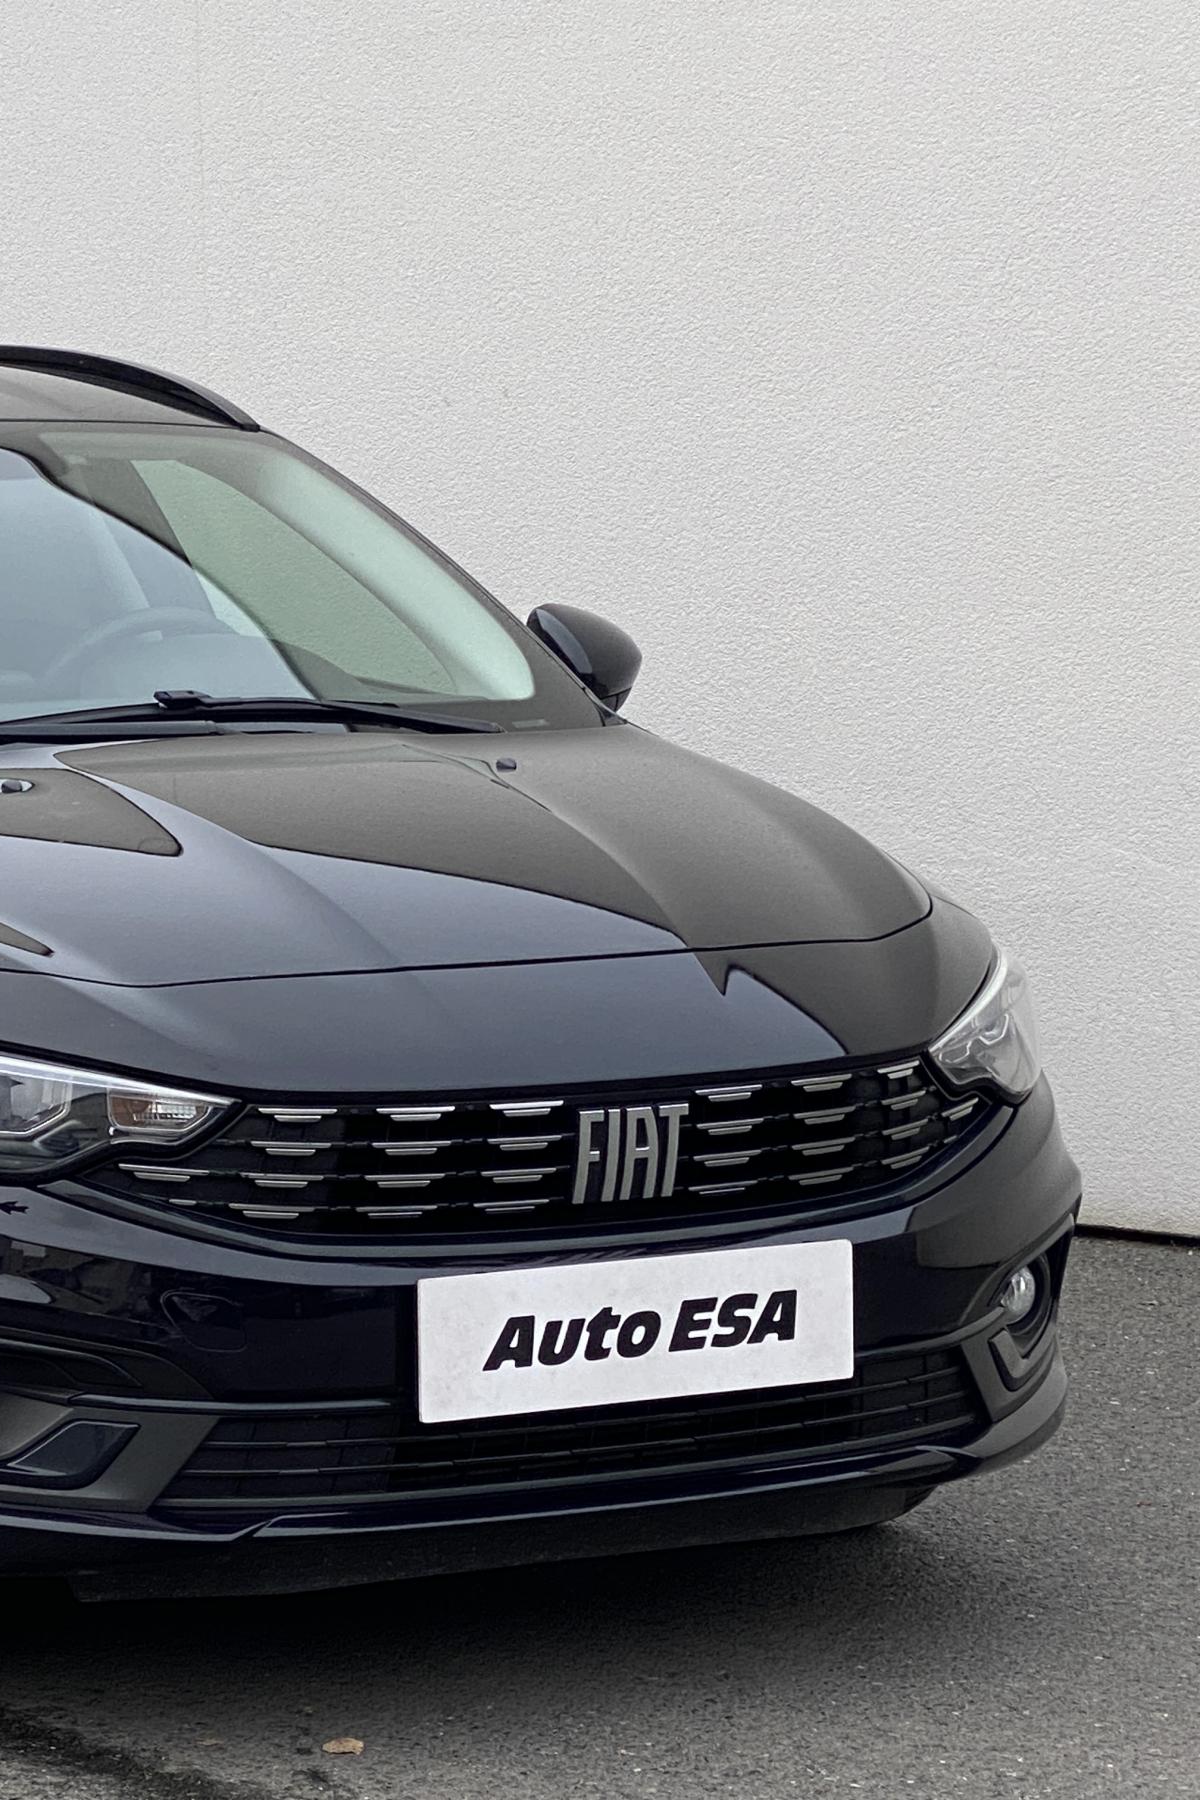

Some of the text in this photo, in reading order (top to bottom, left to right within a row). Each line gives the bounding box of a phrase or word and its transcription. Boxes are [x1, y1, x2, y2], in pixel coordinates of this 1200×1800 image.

[572, 1103, 689, 1204] FIAT
[482, 1289, 798, 1371] Auto ESA
